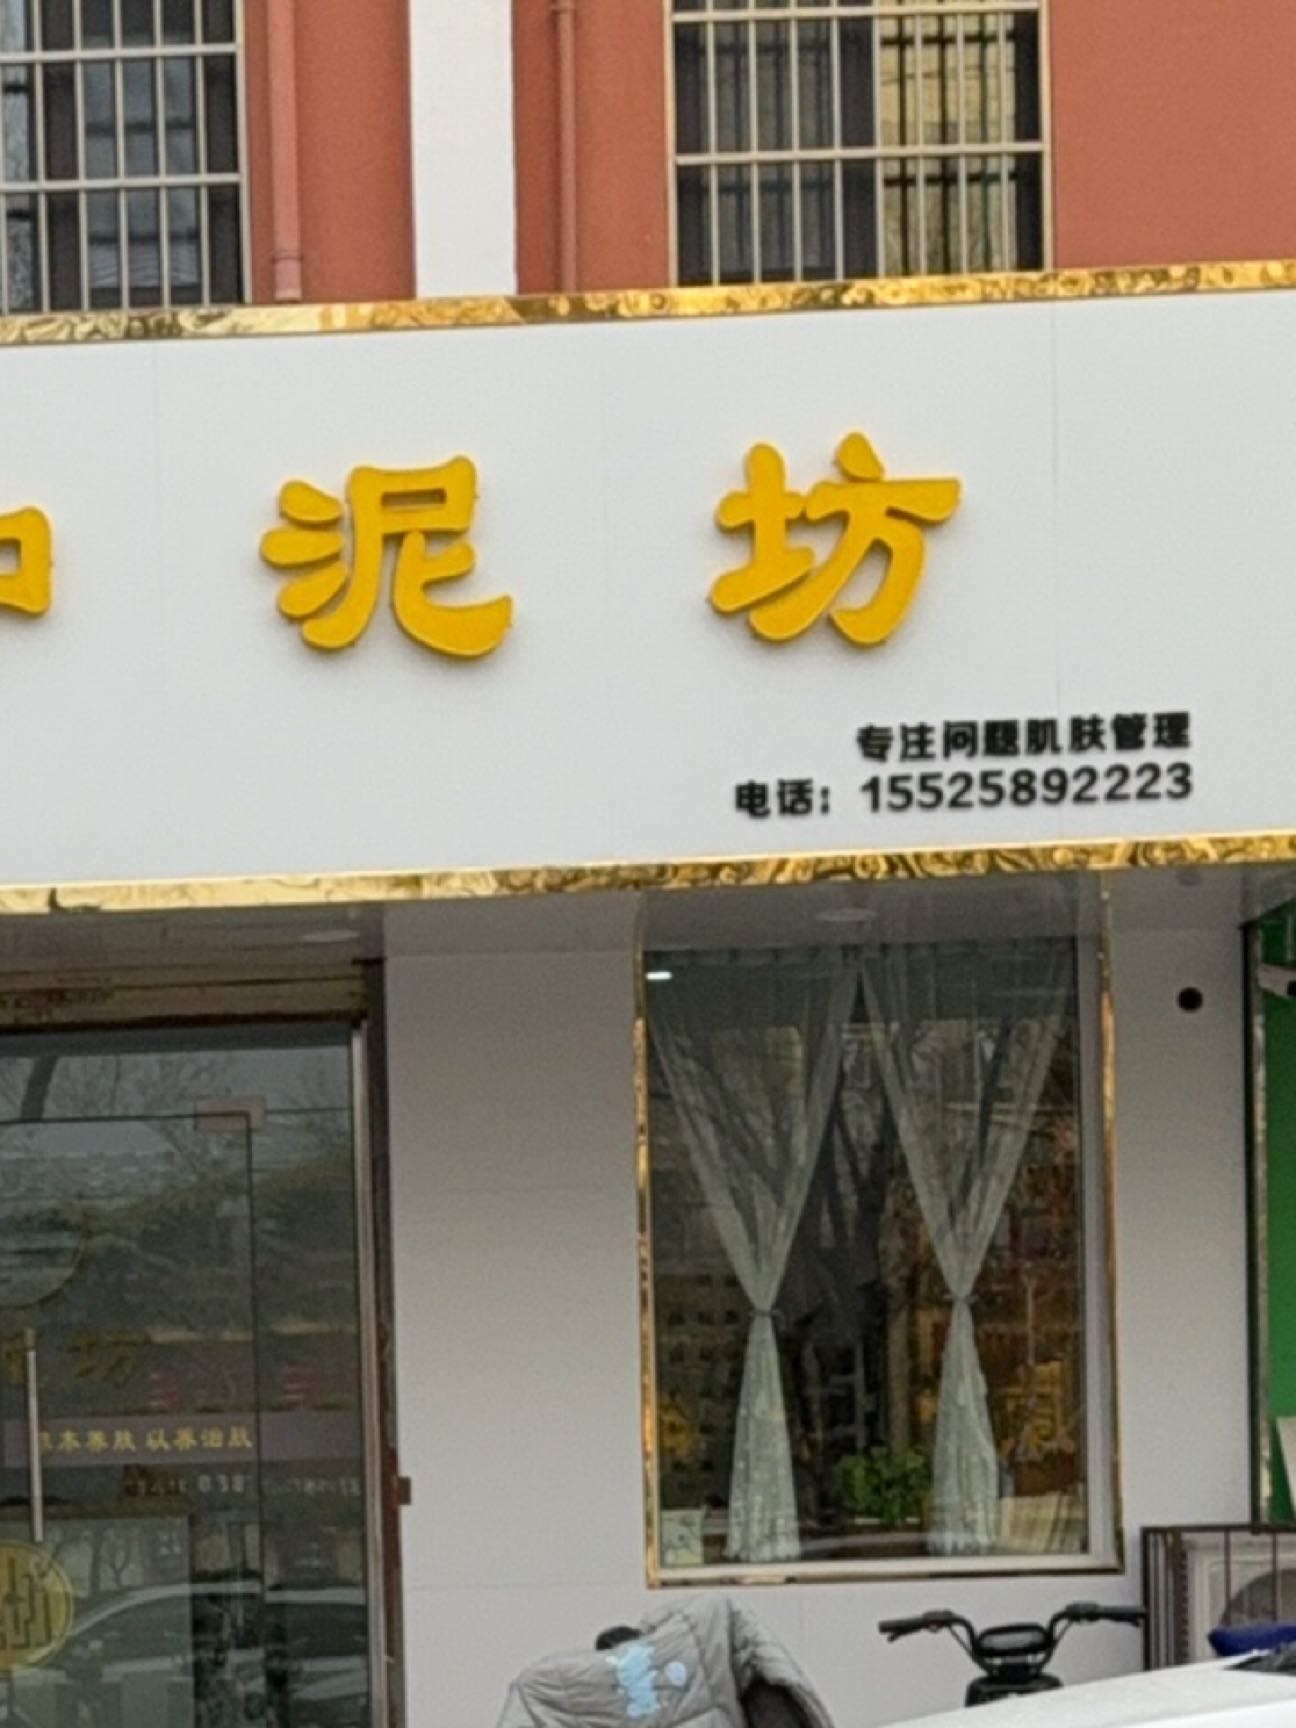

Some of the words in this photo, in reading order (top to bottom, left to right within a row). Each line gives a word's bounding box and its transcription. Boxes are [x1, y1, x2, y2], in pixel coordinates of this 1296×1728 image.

[856, 711, 1191, 763] 专注问题肌肤管理
